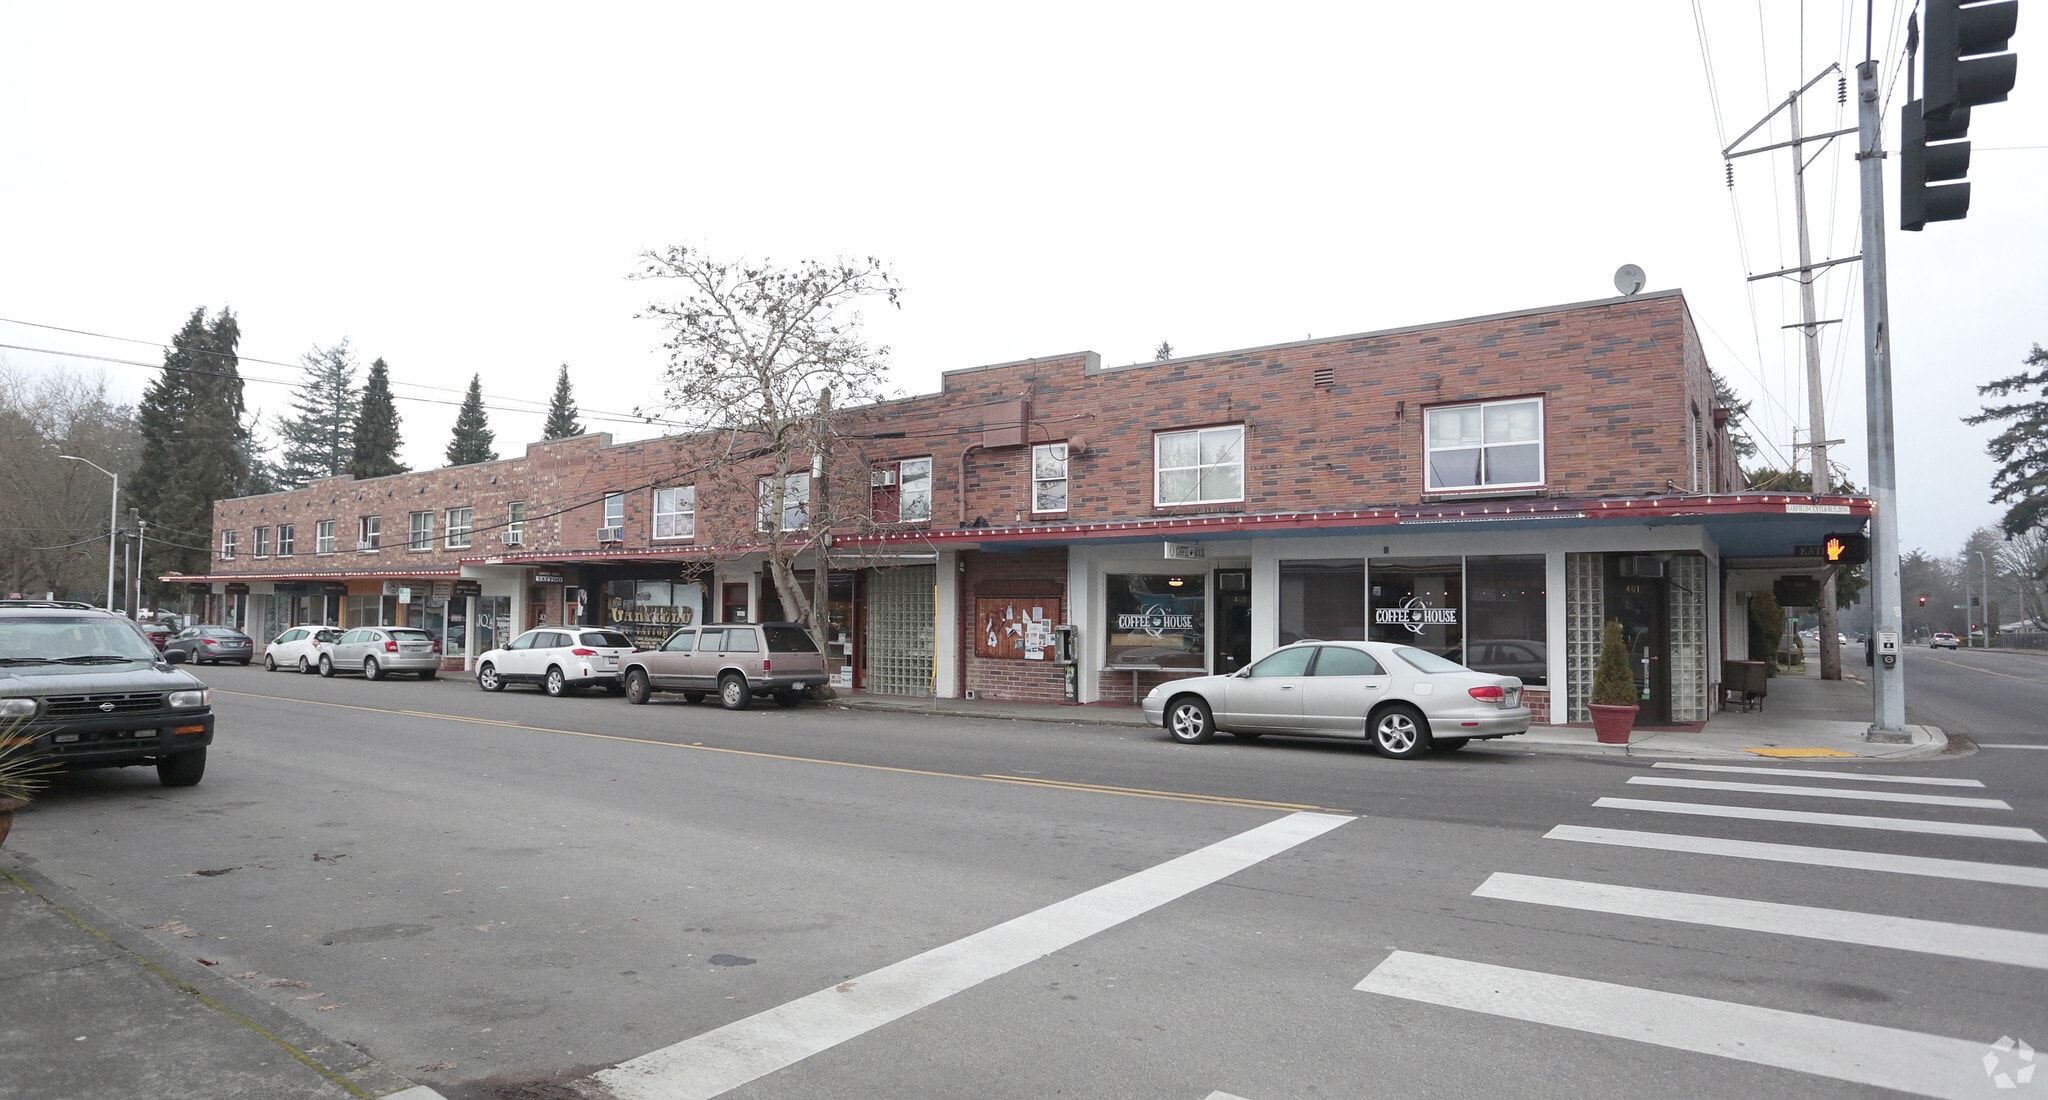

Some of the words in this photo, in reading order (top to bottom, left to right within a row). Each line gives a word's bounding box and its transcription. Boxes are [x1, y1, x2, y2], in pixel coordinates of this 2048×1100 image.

[1625, 585, 1640, 593] 401
[1119, 615, 1150, 627] COFFEE
[1164, 616, 1193, 628] HOUSE
[1376, 610, 1410, 622] COFFEE
[1424, 610, 1456, 622] HOUSE
